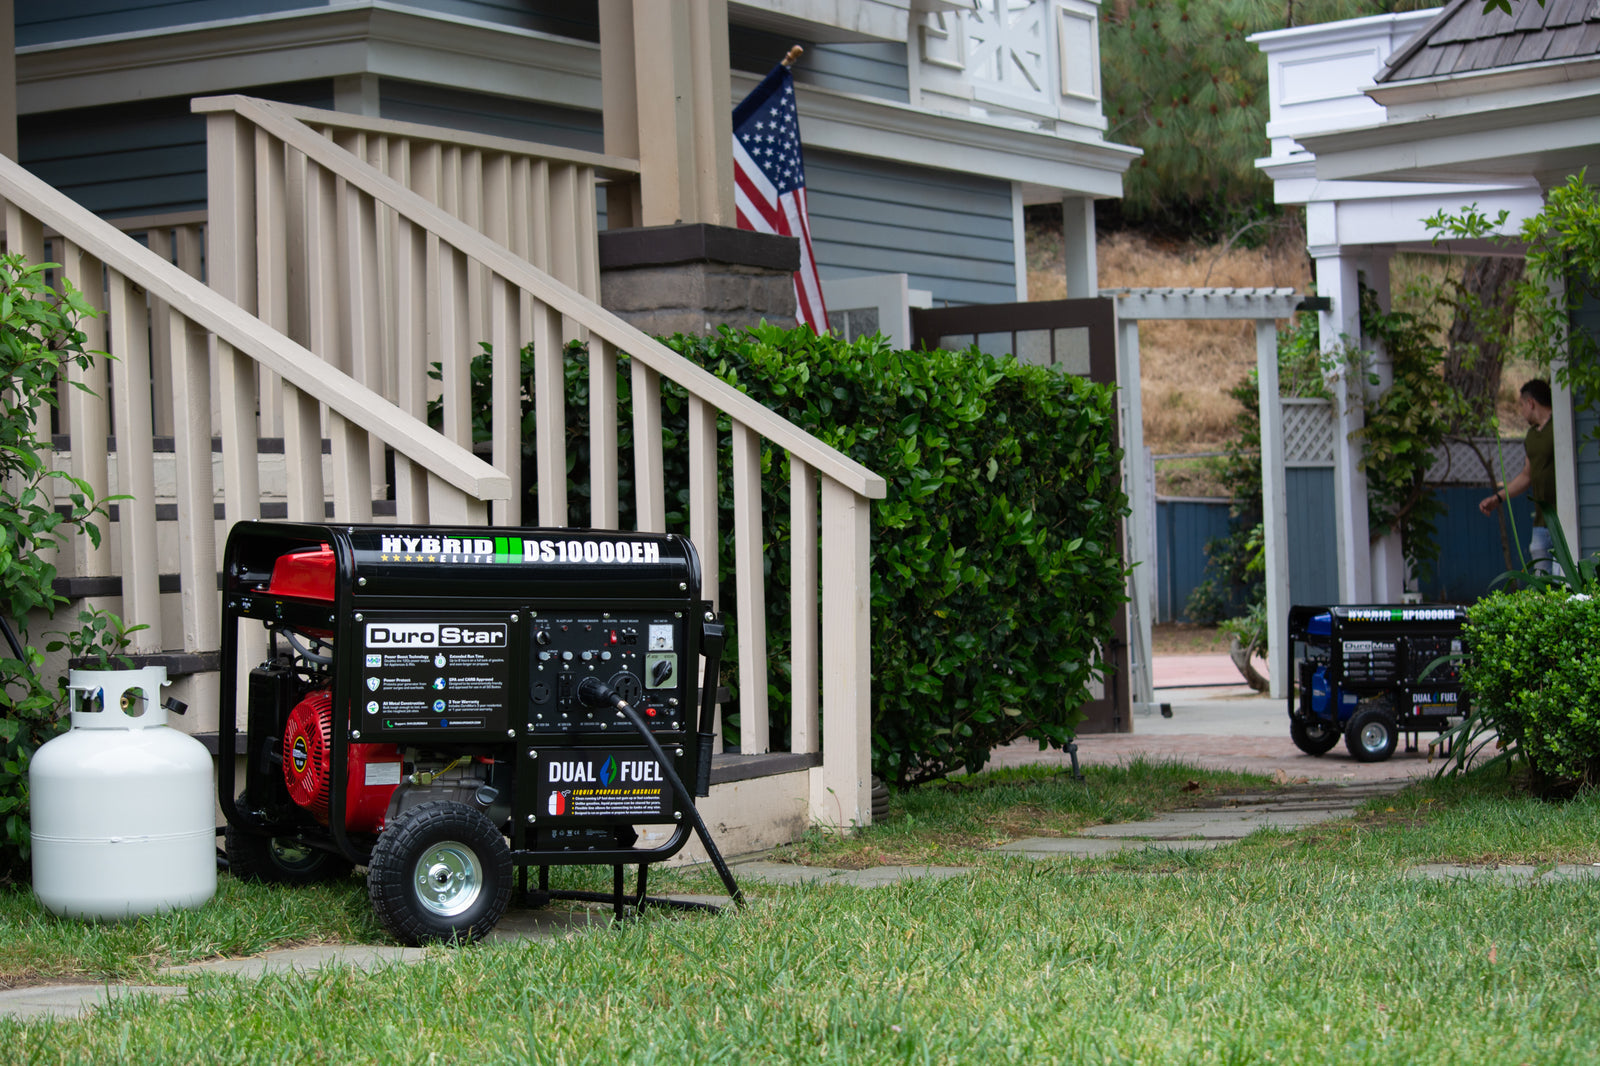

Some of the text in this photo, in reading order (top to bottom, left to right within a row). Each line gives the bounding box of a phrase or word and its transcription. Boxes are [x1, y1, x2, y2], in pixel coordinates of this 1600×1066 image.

[382, 538, 493, 554] HYBRID
[523, 540, 660, 563] DS10000EH
[440, 554, 493, 563] ELITE
[370, 627, 504, 644] DuroStar
[1412, 692, 1431, 702] DUAL
[549, 761, 663, 782] DUAL FUEL
